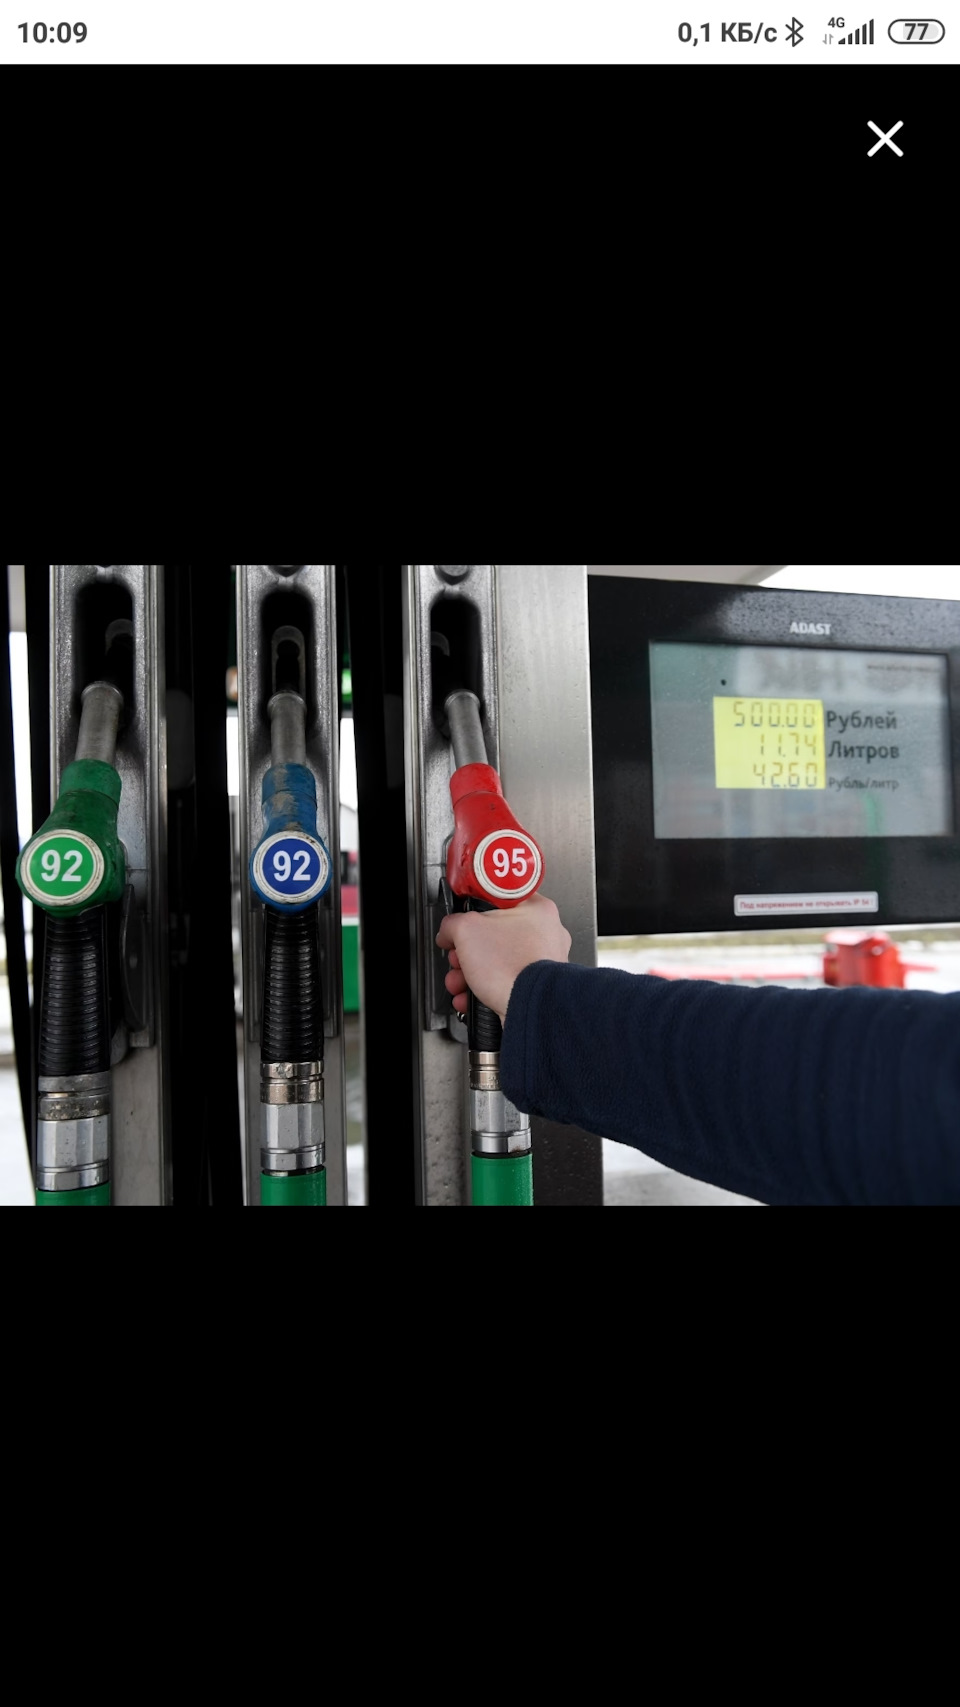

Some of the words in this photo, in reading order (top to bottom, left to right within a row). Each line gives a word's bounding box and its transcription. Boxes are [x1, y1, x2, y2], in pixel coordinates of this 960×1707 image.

[790, 621, 832, 635] ADAST
[733, 701, 816, 728] 500.00
[826, 711, 897, 733] Рублей
[760, 733, 817, 757] 11.74
[827, 740, 900, 764] Литров
[753, 762, 818, 788] 42.60
[828, 776, 900, 790] Рубль/литр
[41, 850, 83, 882] 92
[273, 850, 311, 882] 92
[492, 848, 528, 878] 95
